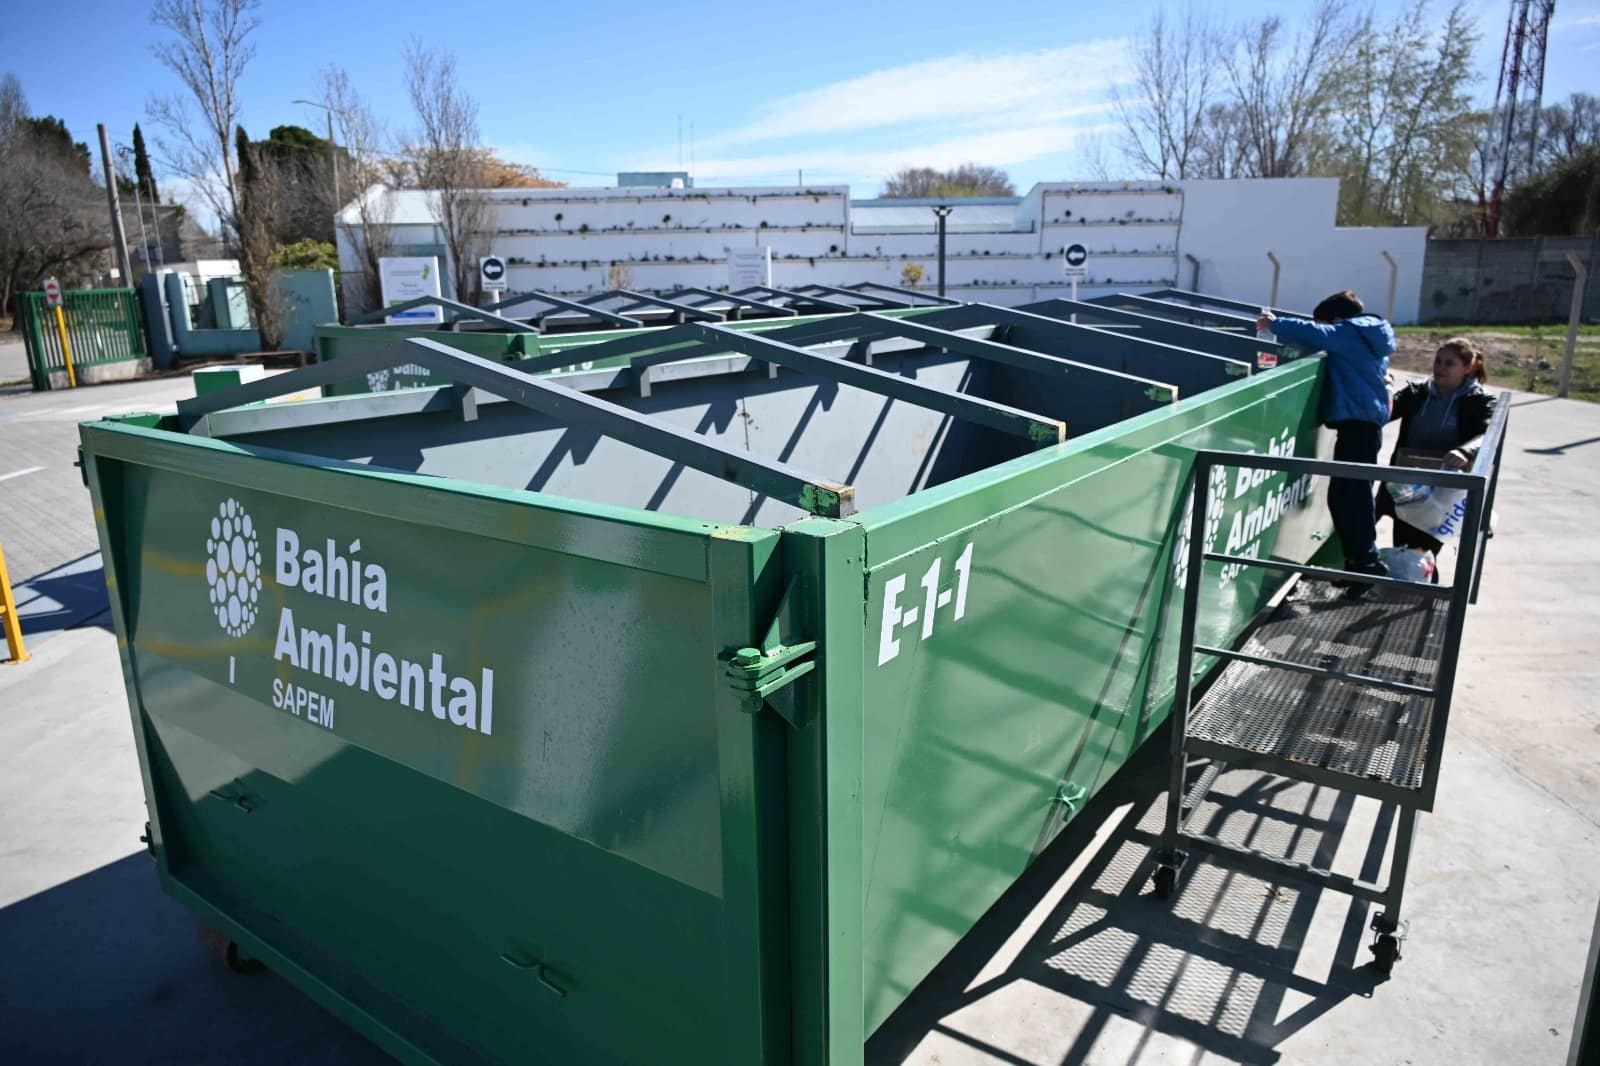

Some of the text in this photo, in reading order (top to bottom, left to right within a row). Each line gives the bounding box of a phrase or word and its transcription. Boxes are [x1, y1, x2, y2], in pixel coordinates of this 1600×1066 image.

[275, 527, 388, 613] Bahía
[878, 541, 974, 667] E-1-1
[272, 678, 335, 729] SAPEM
[273, 607, 494, 736] Ambiental
